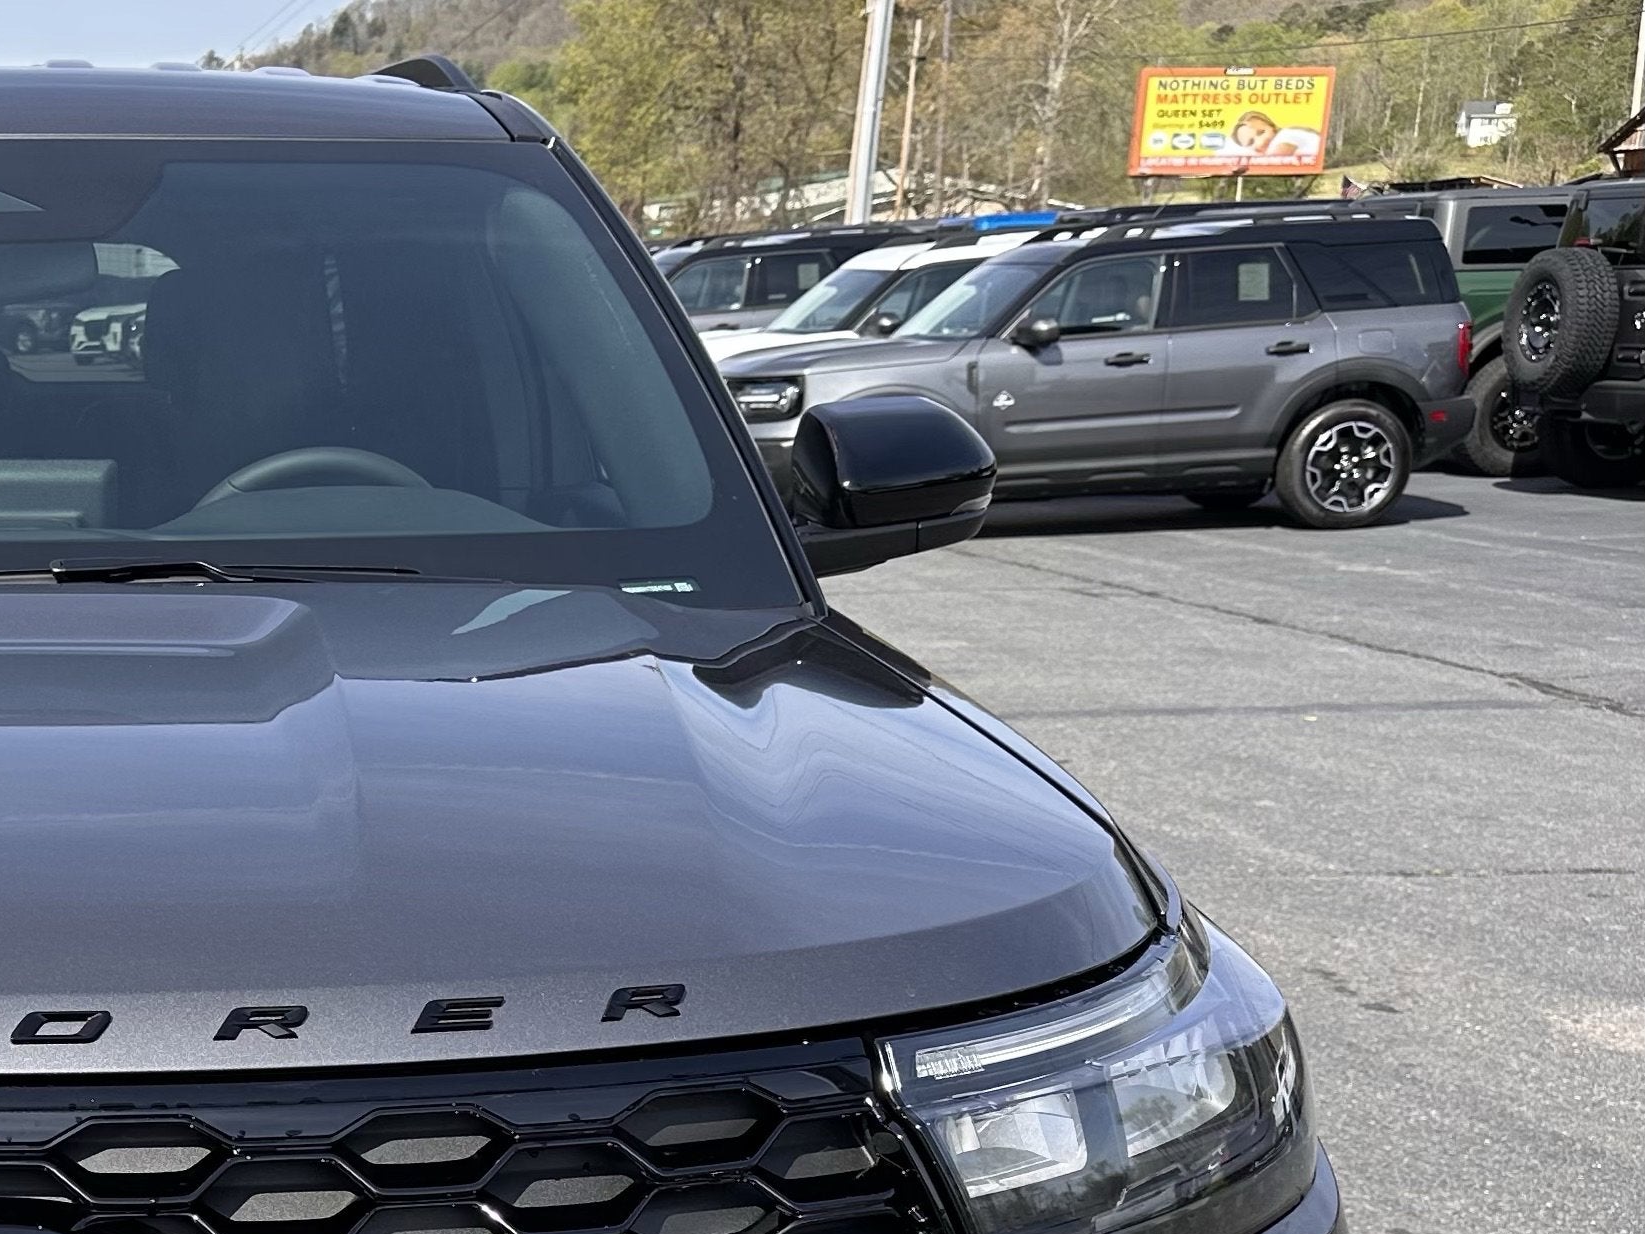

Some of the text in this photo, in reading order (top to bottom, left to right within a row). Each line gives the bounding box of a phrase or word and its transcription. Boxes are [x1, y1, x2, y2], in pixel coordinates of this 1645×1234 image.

[1157, 78, 1315, 91] NOTHING BUT BEDS
[1156, 93, 1313, 105] MATTRESS OUTLET
[1156, 108, 1222, 118] QUEEN SET
